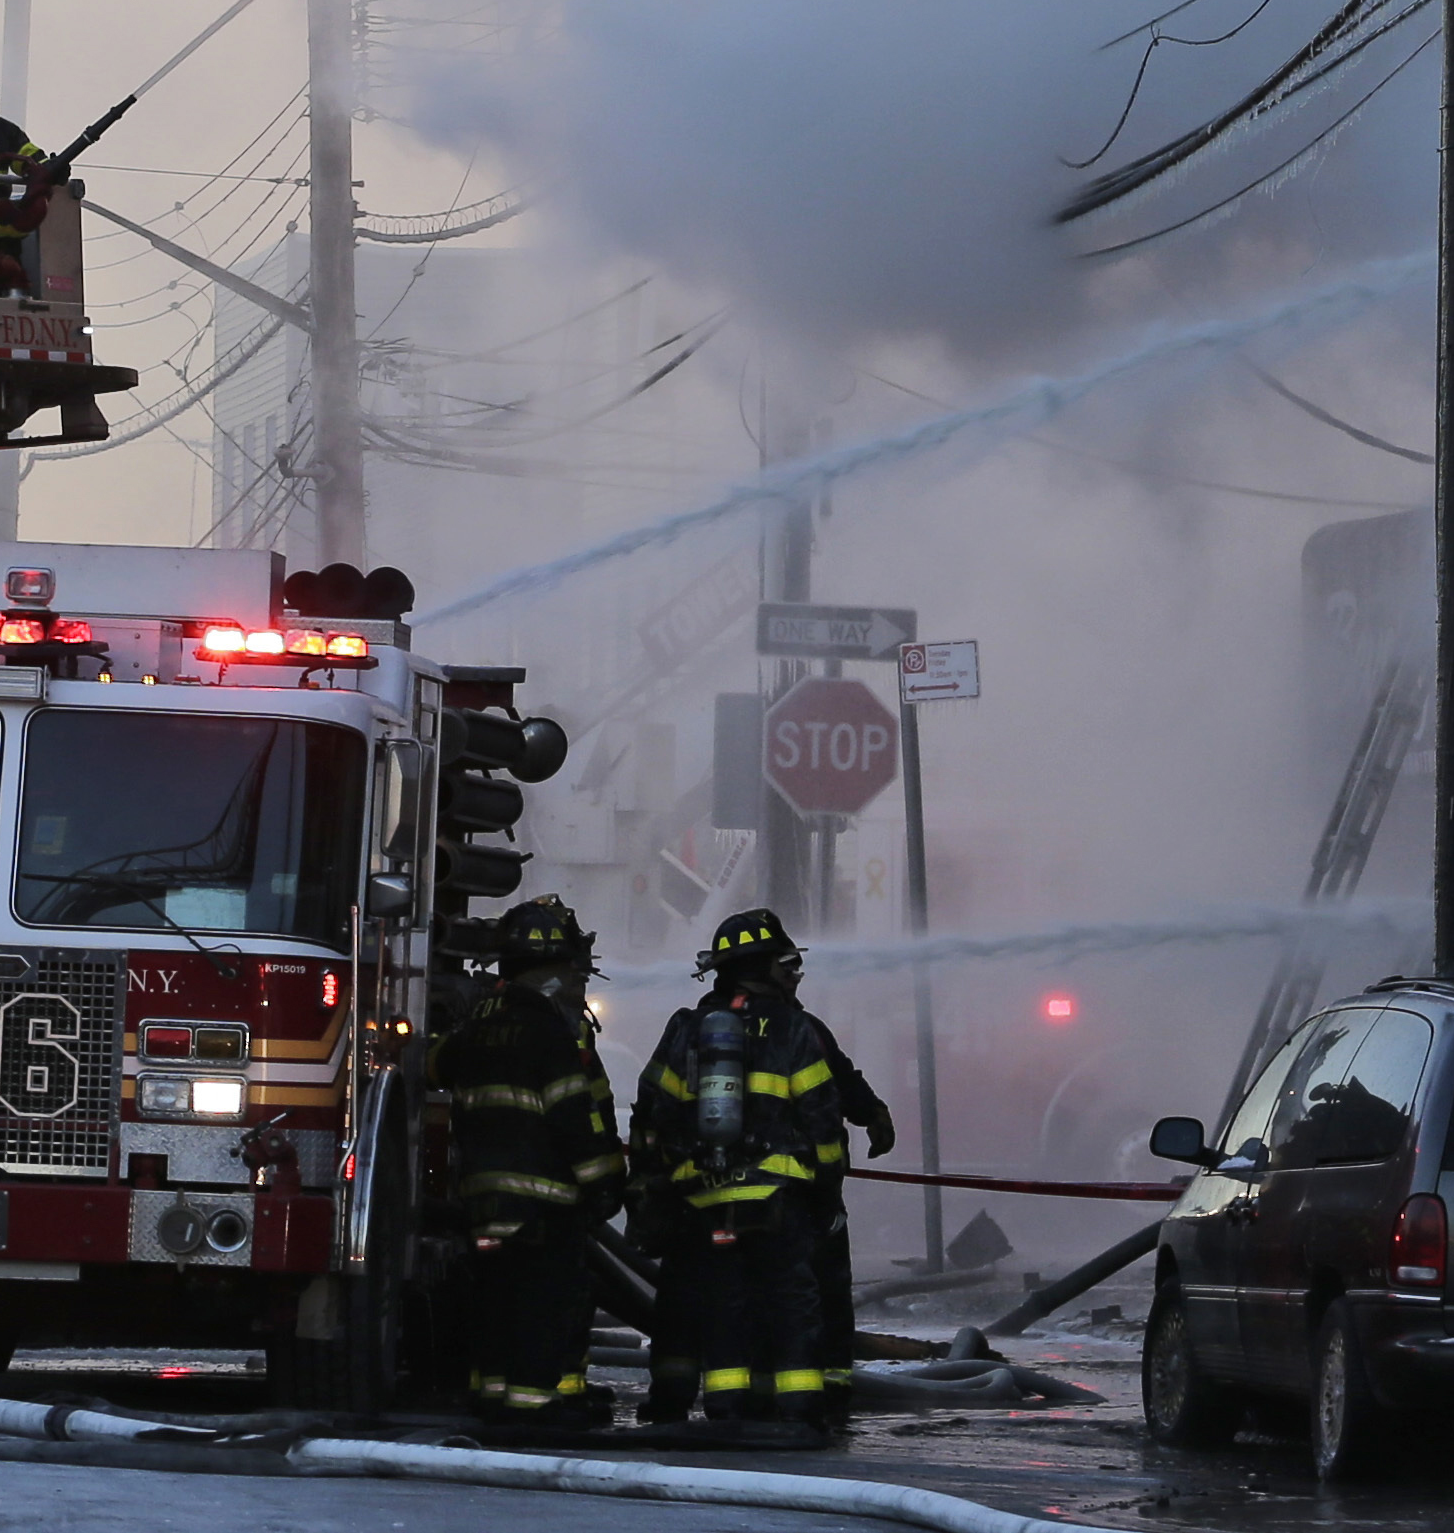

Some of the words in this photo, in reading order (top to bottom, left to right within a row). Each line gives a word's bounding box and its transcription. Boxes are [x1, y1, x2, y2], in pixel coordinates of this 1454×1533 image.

[1, 315, 78, 349] F.D.N.Y.
[774, 621, 816, 641] ONE
[827, 622, 873, 642] WAY
[774, 720, 889, 773] STOP
[265, 963, 306, 974] KP15019
